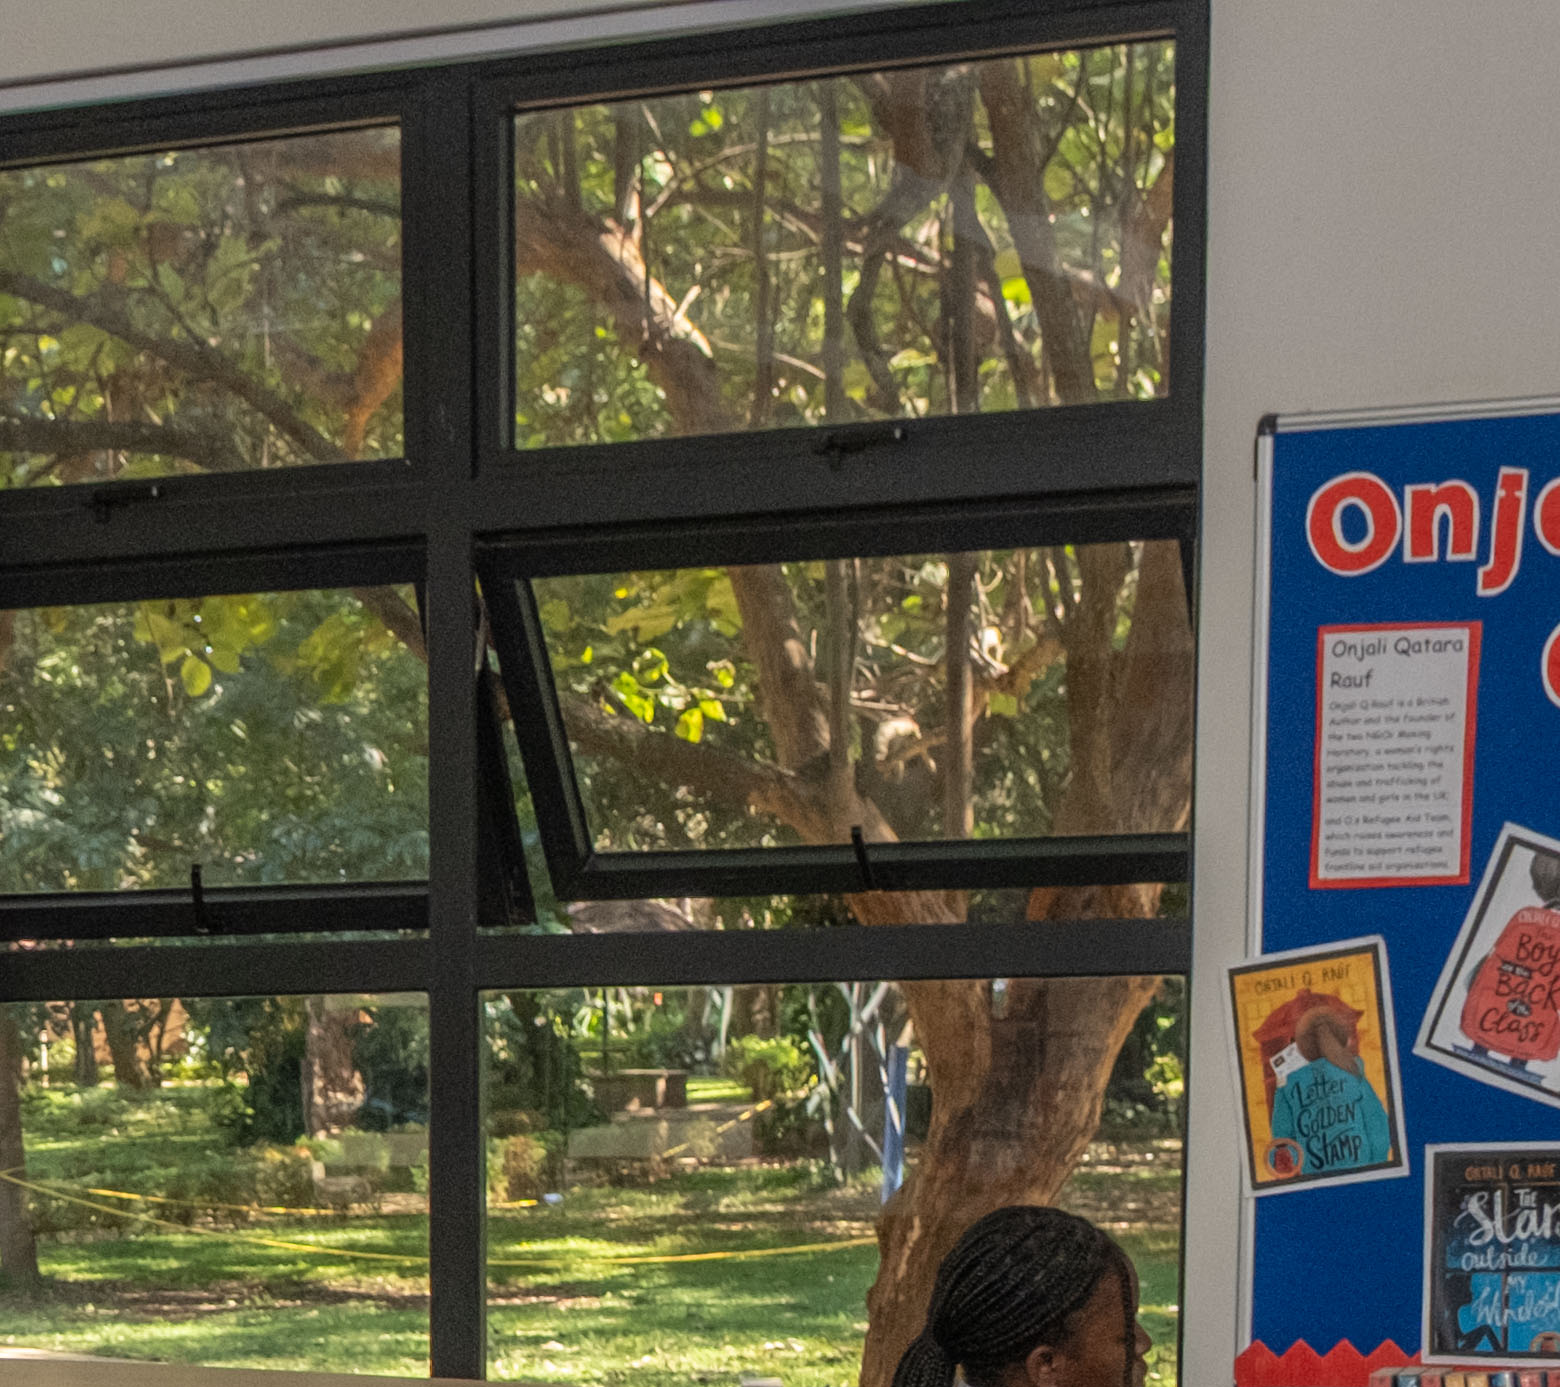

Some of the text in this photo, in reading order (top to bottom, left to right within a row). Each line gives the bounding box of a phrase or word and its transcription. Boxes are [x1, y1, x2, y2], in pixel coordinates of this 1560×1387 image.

[1332, 636, 1464, 662] Onjali Qatara
[1330, 668, 1374, 689] Rauf
